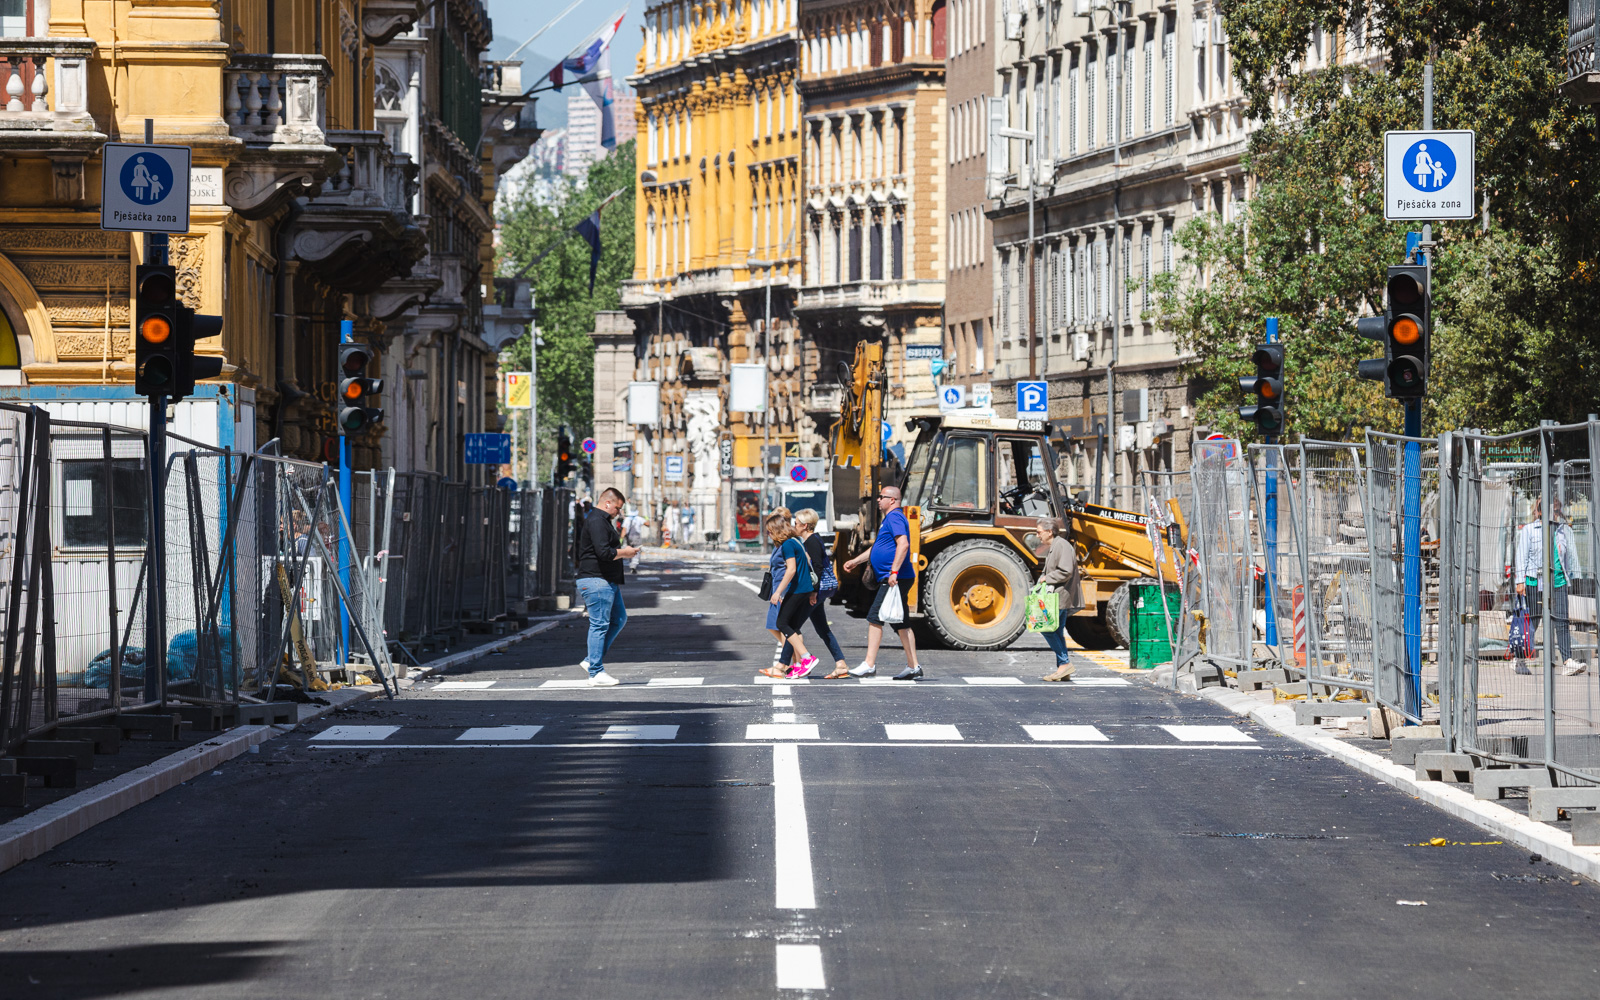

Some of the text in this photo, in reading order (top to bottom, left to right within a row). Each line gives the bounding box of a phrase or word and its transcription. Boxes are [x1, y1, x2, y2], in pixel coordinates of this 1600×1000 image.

[190, 189, 217, 197] OJSKE
[1397, 199, 1461, 211] Pješačka zona
[114, 210, 177, 222] Pješačka zona
[907, 348, 940, 357] SEIKO
[1024, 390, 1041, 411] P
[1018, 420, 1042, 431] 438B
[1099, 510, 1113, 519] ALL
[1113, 512, 1137, 523] WHEEL
